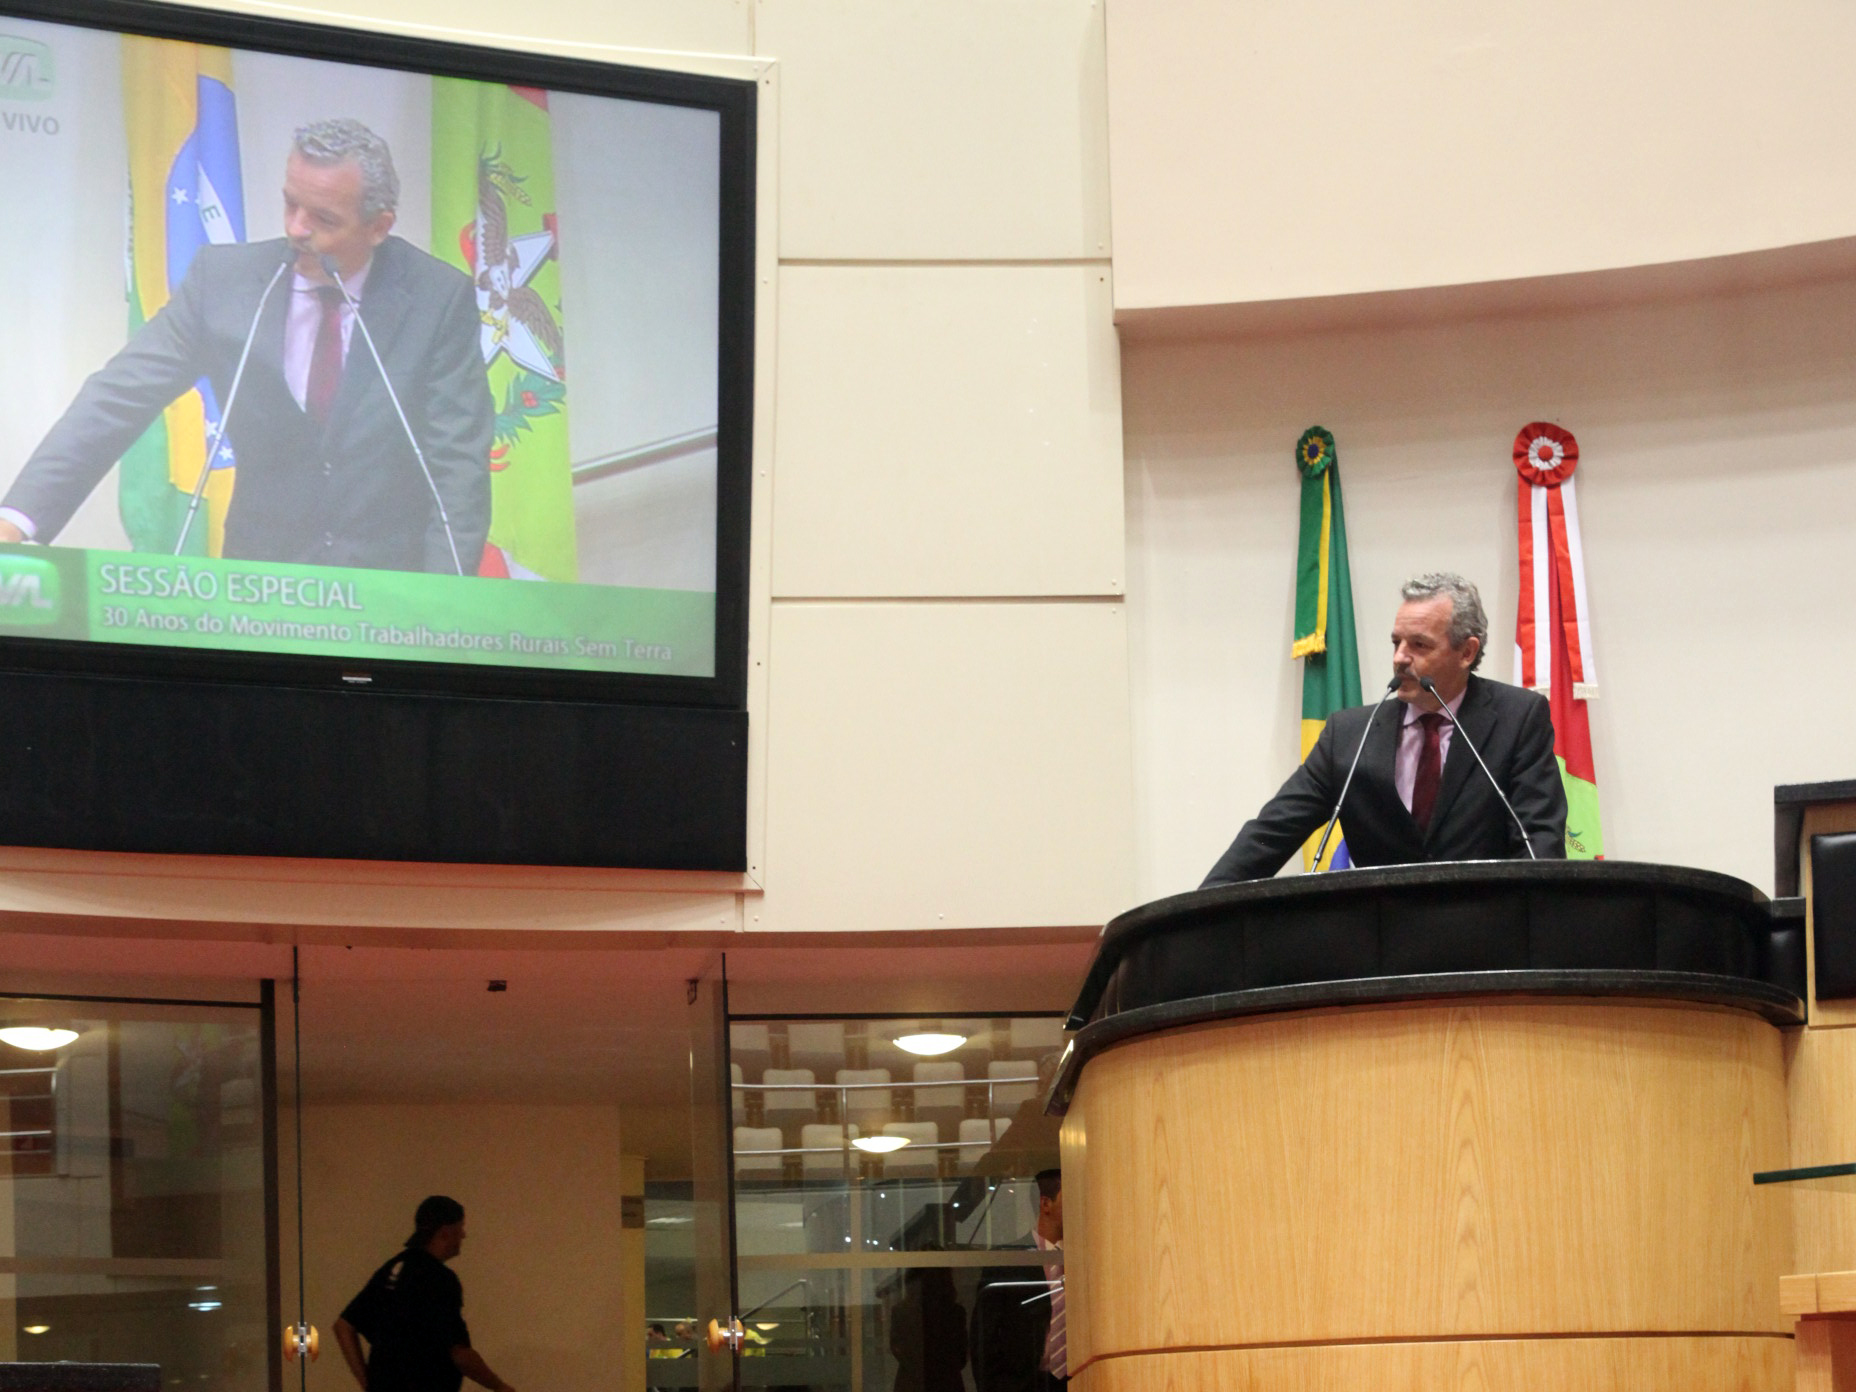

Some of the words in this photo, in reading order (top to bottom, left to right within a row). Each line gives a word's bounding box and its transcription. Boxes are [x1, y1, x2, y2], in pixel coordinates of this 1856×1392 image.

[1, 111, 60, 136] VIVO
[100, 563, 218, 600] SESSÃO
[226, 572, 363, 610] ESPECIAL
[103, 606, 128, 627] 30
[135, 609, 189, 632] Anos
[195, 613, 223, 633] do
[229, 615, 351, 641] Movimento
[357, 622, 503, 650] Trabalhadores
[509, 632, 569, 655] Rurais
[575, 636, 617, 657] Sem
[623, 639, 672, 661] Terra
